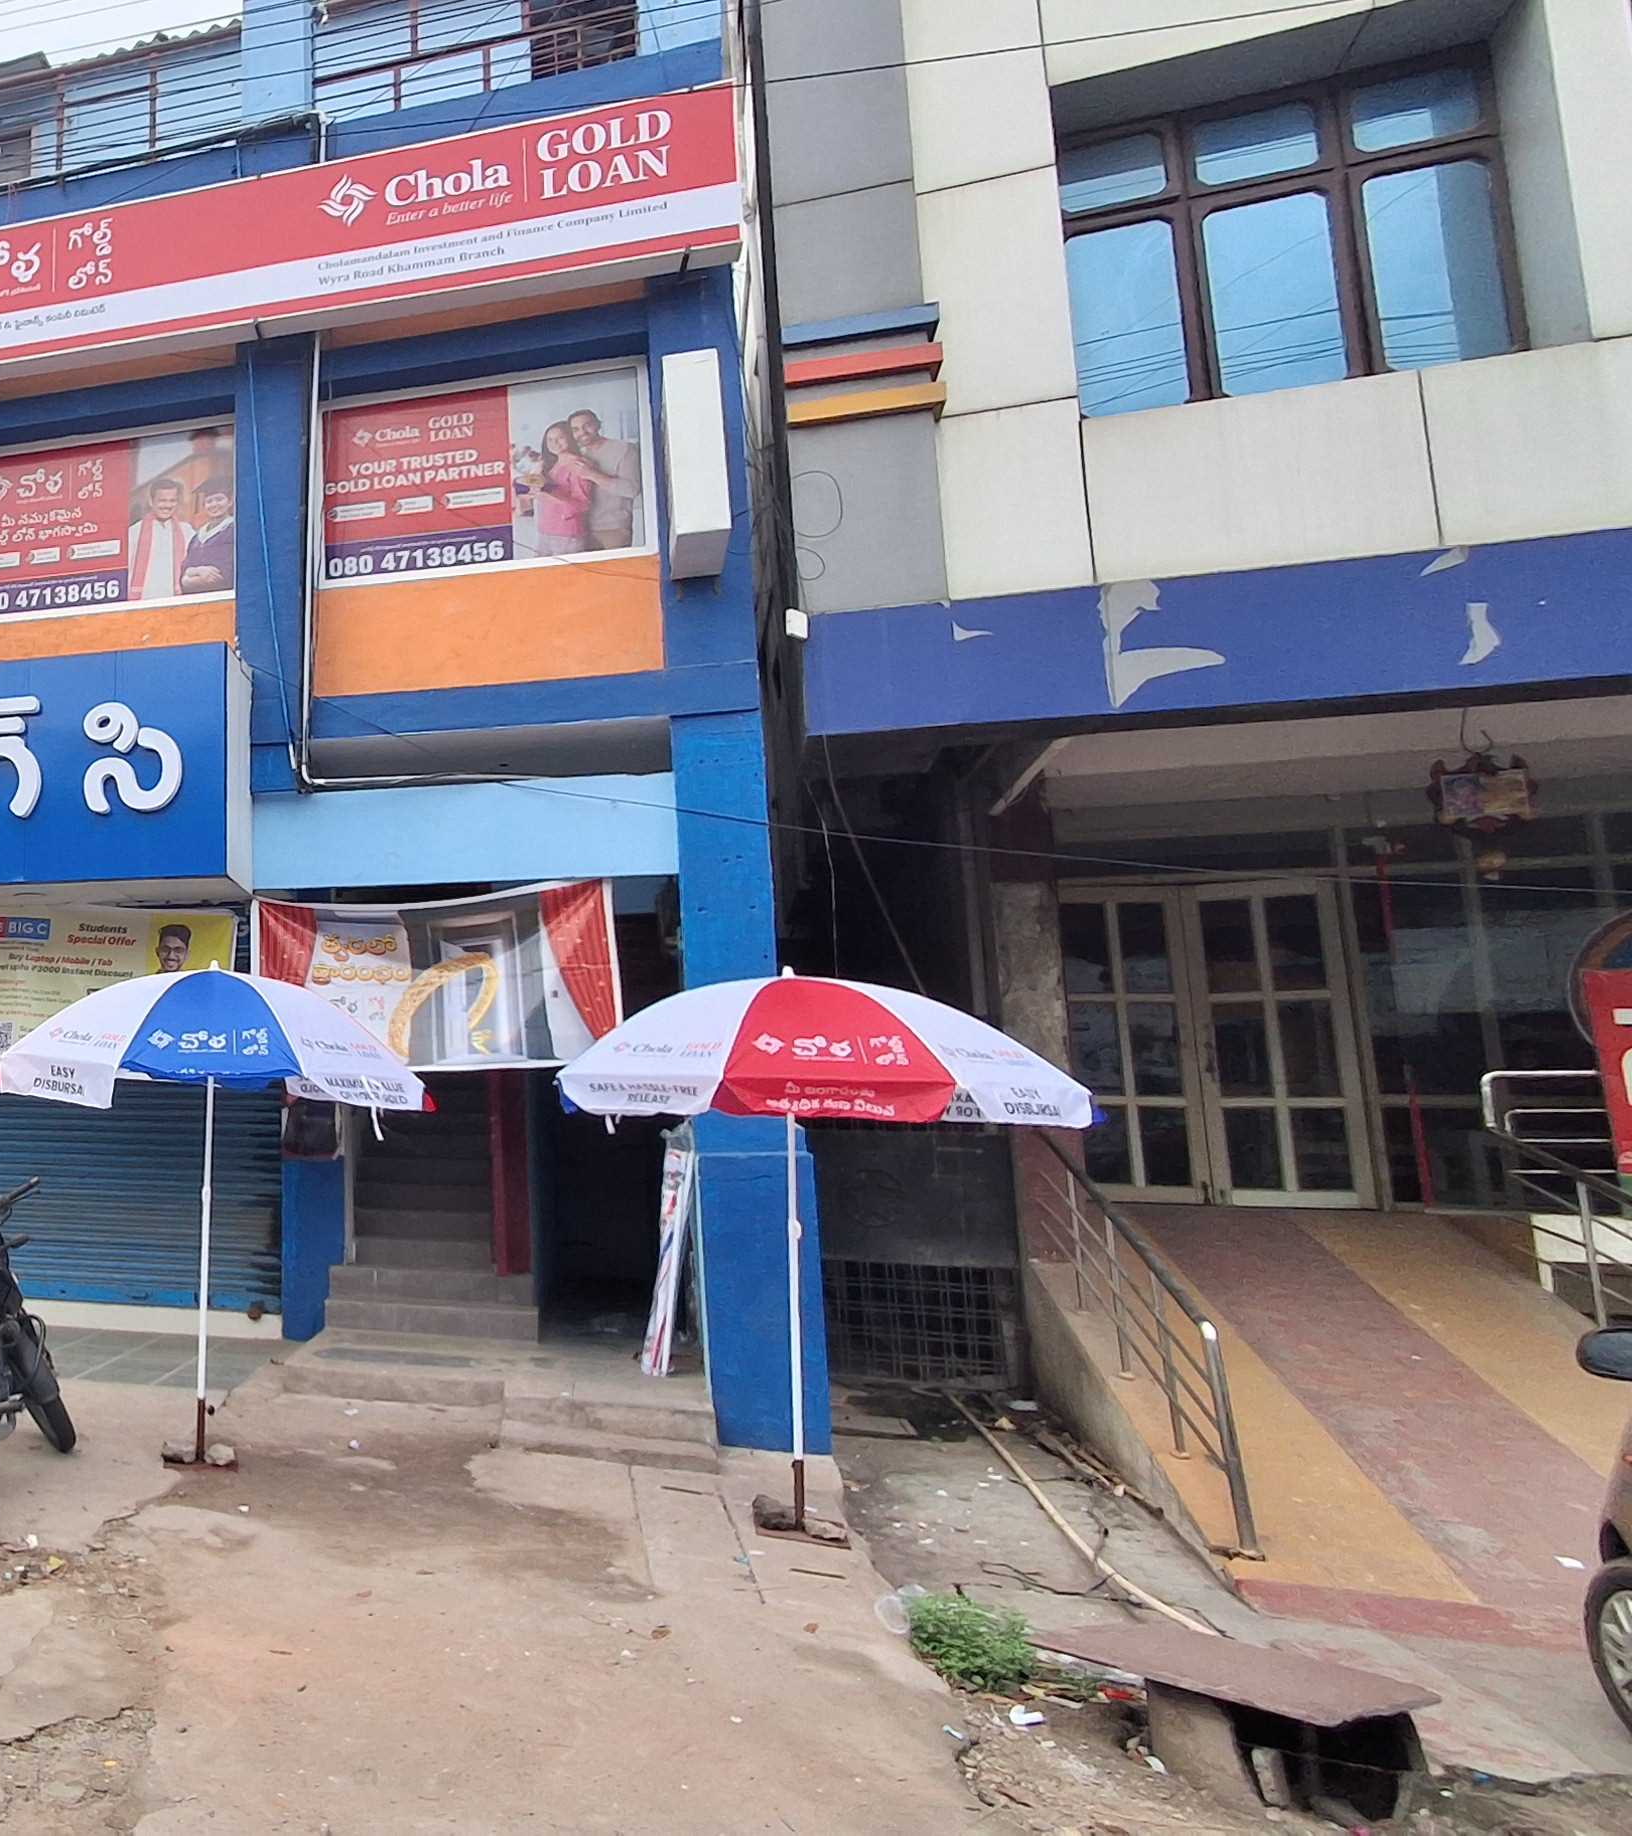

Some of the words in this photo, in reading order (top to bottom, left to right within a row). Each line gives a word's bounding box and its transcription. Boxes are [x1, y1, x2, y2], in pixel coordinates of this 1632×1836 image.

[536, 110, 672, 163] GOLD
[385, 159, 511, 206] Chola
[539, 145, 670, 200] LOAN
[386, 207, 426, 226] Enter
[428, 206, 439, 217] a
[442, 197, 486, 216] better
[489, 192, 513, 210] life
[317, 247, 411, 271] Cholamandalam
[413, 236, 479, 256] Investment
[481, 231, 504, 245] and
[507, 223, 554, 240] Finance
[556, 213, 616, 232] Company
[619, 201, 669, 220] Limited
[318, 268, 351, 287] Wyra
[353, 266, 384, 282] Road
[387, 254, 456, 275] Khammam
[459, 245, 506, 263] Branch
[428, 412, 475, 430] GOLD
[374, 426, 420, 443] Chola
[429, 426, 474, 443] LOAN
[348, 457, 398, 477] YOUR
[400, 449, 479, 471] TRUSTED
[325, 478, 370, 496] GOLD
[373, 471, 422, 488] LOAN
[424, 462, 506, 485] PARTNER
[328, 554, 374, 577] 080
[380, 540, 505, 572] 47138456
[15, 579, 120, 608] 47138456
[82, 701, 184, 815] సి
[7, 921, 34, 934] BIG
[36, 923, 49, 935] C
[78, 922, 130, 934] Students
[67, 934, 106, 945] Special
[107, 936, 137, 947] Offer
[8, 953, 24, 962] Buy
[25, 954, 55, 964] Laptop
[61, 956, 90, 965] Mobile
[97, 958, 113, 967] Tab
[61, 967, 94, 977] Instant
[94, 969, 134, 979] Discount
[311, 963, 412, 985] ప్రారంభం
[50, 1064, 76, 1079] EASY
[33, 1077, 85, 1097] DISBURSA
[589, 1083, 616, 1093] SAFE
[1010, 1087, 1042, 1100] EASY
[627, 1093, 671, 1105] RELEASE
